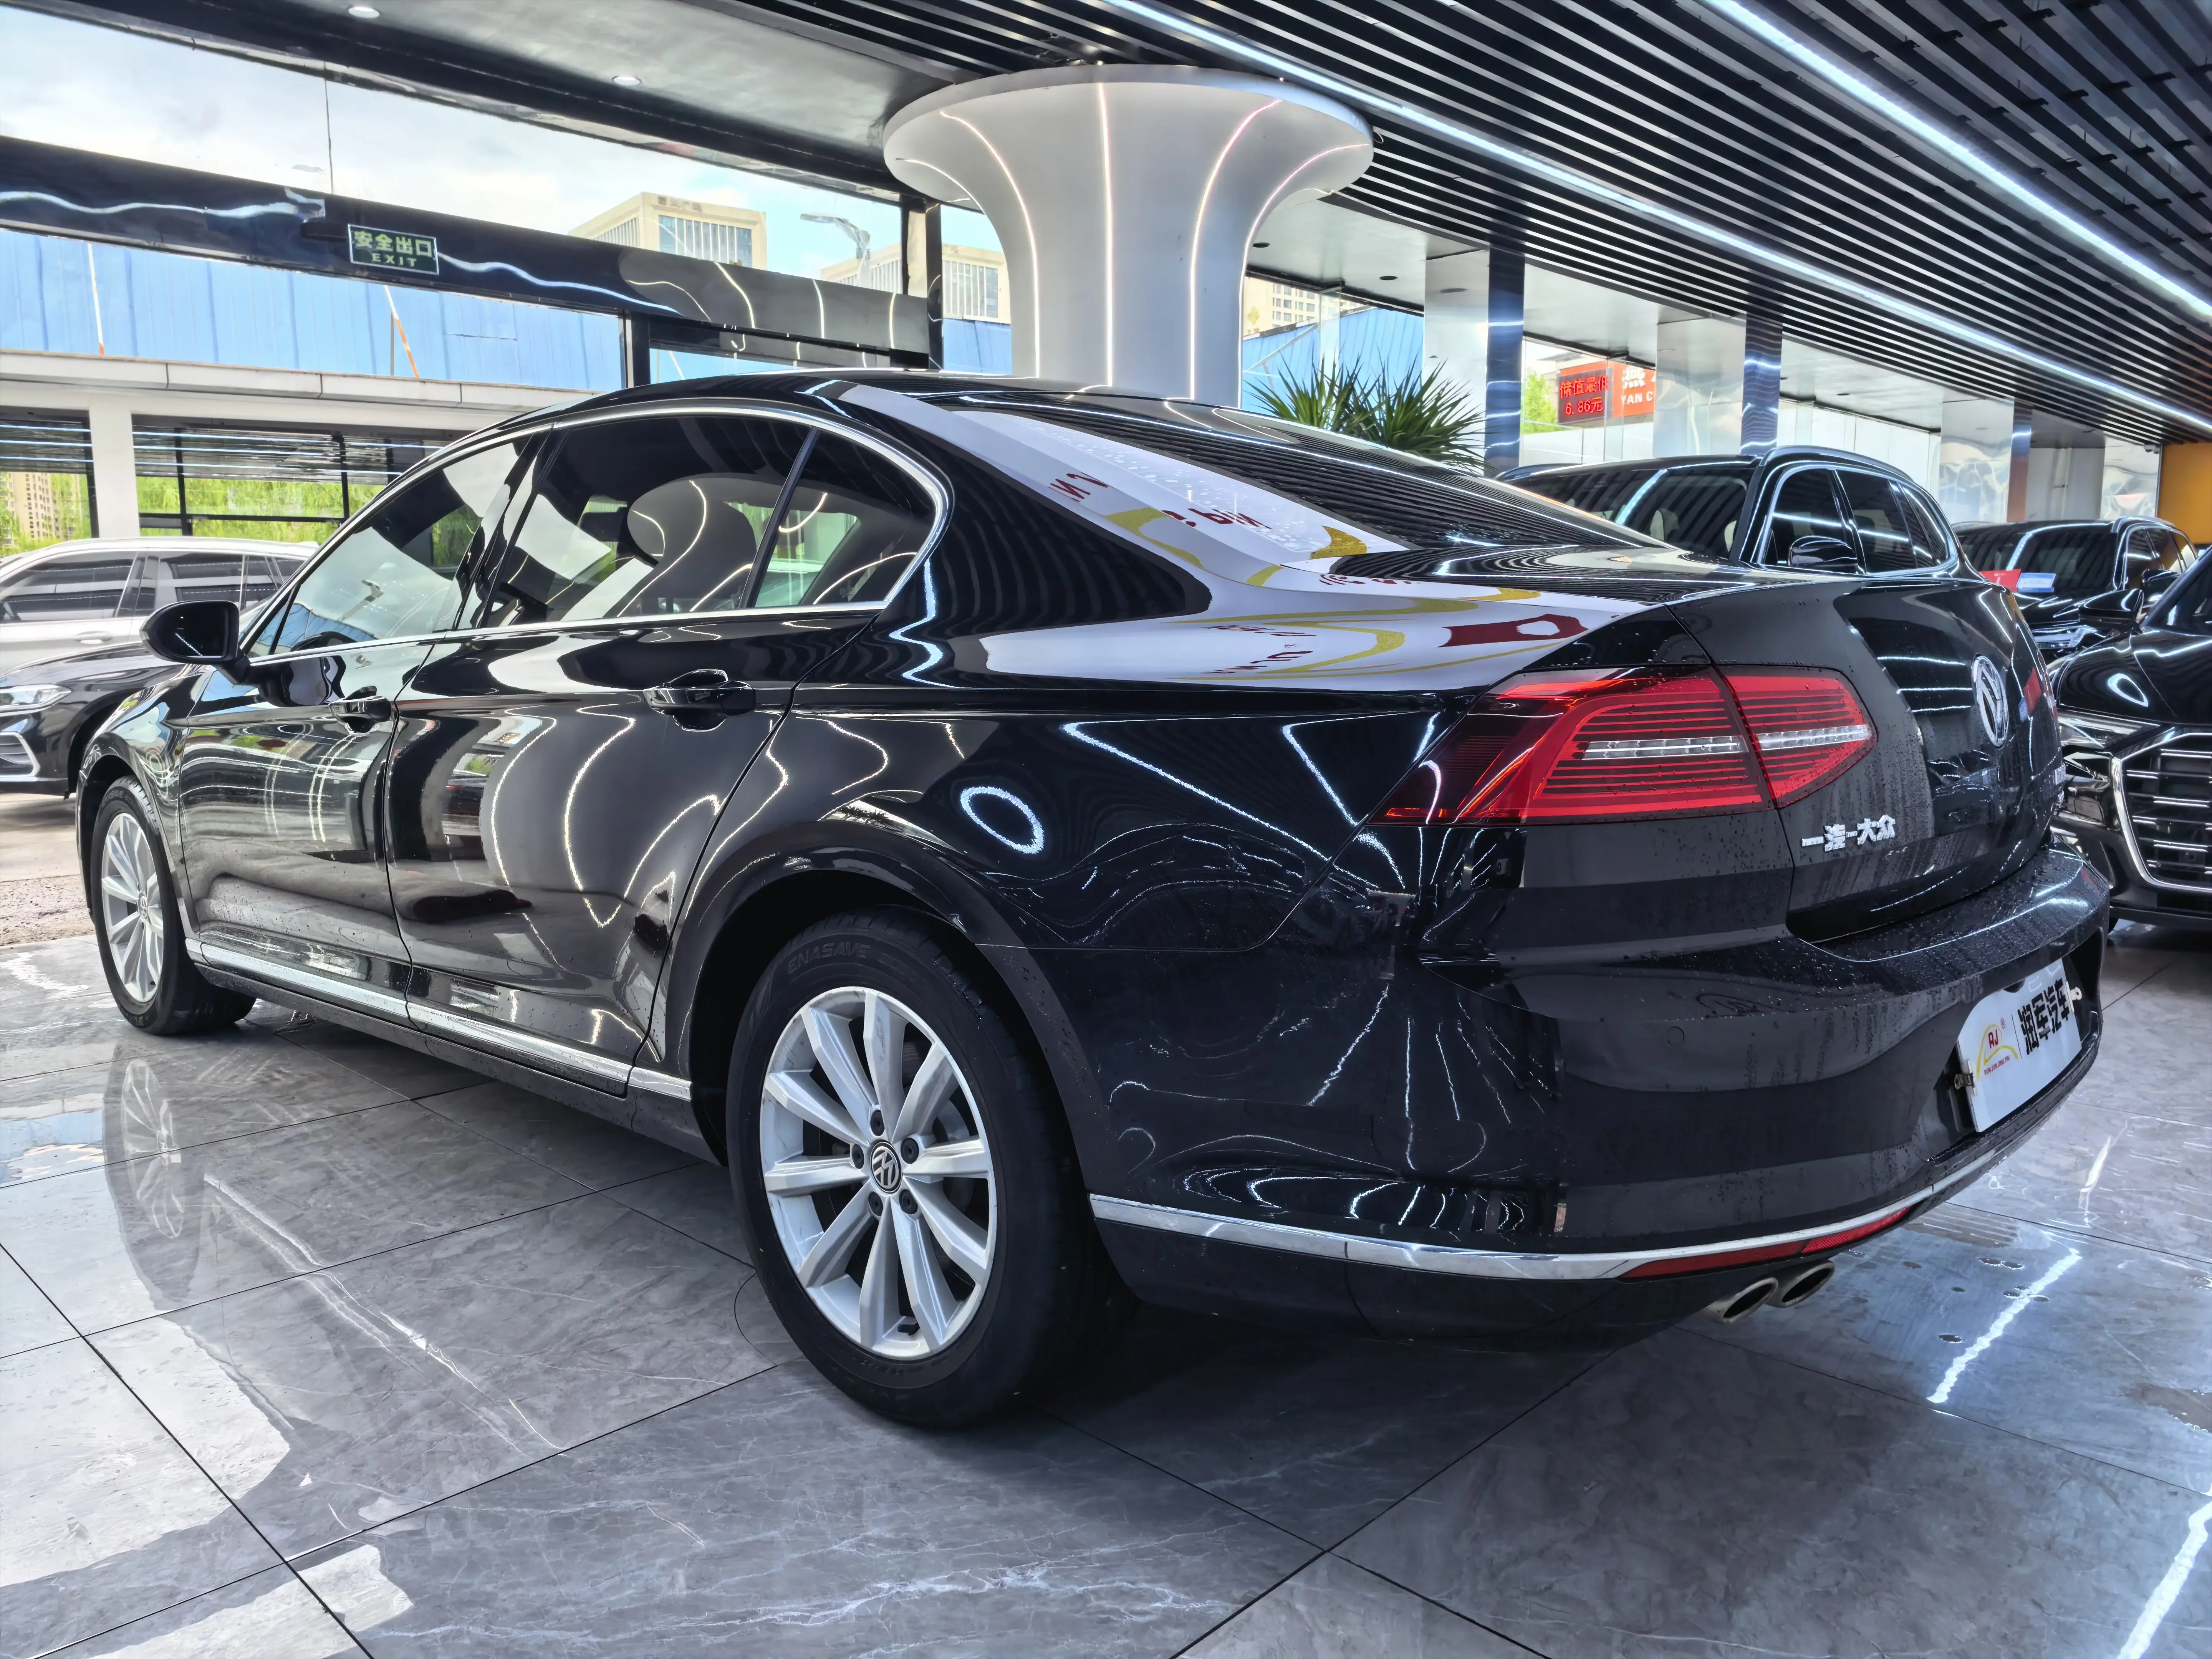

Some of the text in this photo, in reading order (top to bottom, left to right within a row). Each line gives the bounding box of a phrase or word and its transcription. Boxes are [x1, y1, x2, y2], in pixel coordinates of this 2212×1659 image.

[354, 230, 432, 257] 安全出口
[372, 253, 417, 267] EXIT
[1621, 392, 1643, 405] YAN
[787, 942, 870, 974] ENASAVE
[2017, 978, 2070, 1055] 润军汽车
